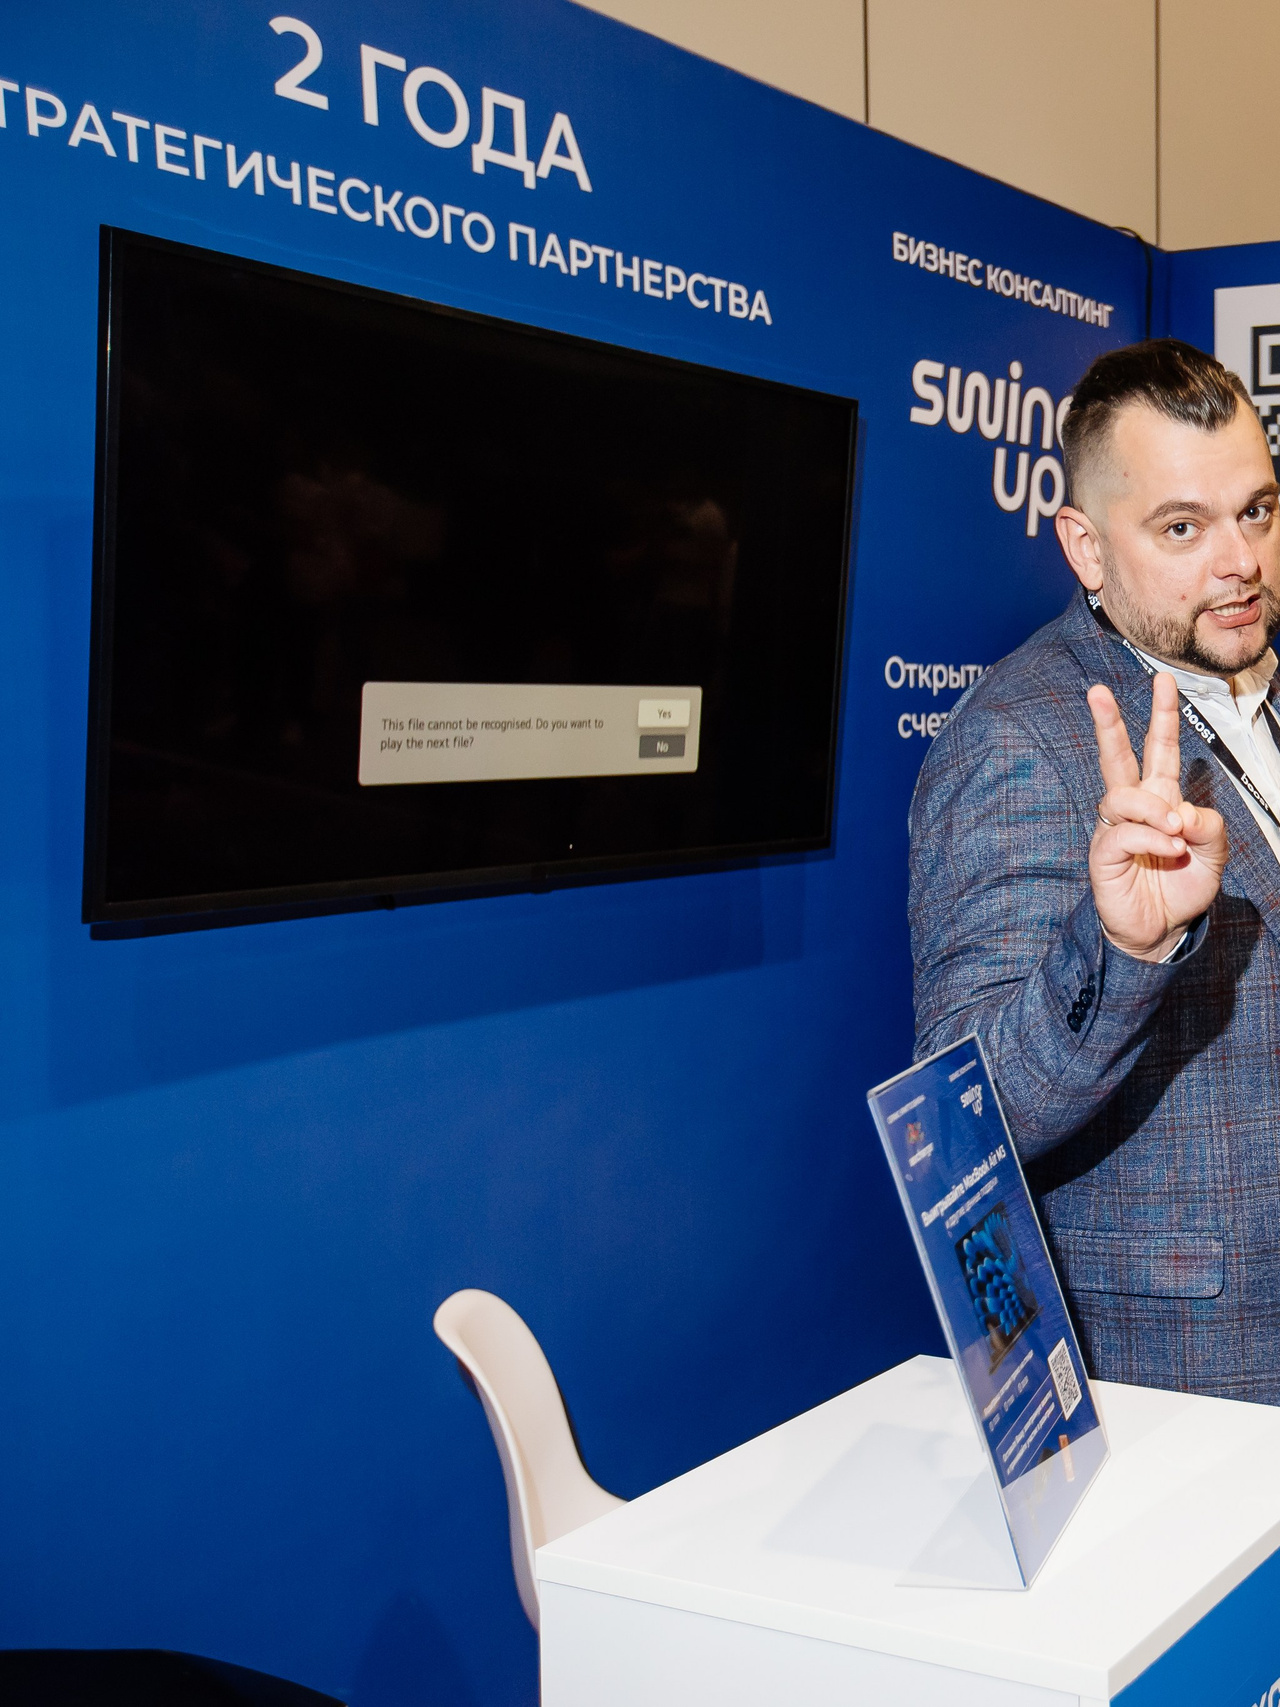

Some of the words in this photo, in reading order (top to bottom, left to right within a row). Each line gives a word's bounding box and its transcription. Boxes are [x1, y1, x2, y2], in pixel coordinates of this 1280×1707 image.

[268, 15, 329, 111] 2
[359, 43, 593, 193] ГОДА
[508, 222, 773, 325] ПАРТНЕРСТВА
[892, 231, 983, 288] БИЗНЕС
[985, 264, 1115, 328] КОНСАЛТИНГ
[910, 359, 1074, 450] swin
[992, 447, 1066, 537] up
[382, 717, 404, 731] This
[408, 717, 425, 731] file
[427, 719, 463, 731] cannot
[466, 717, 478, 730] be
[535, 718, 548, 730] Do
[551, 720, 567, 732] you
[570, 719, 591, 730] want
[594, 719, 604, 730] to
[657, 708, 672, 720] Yes
[1182, 703, 1216, 744] boost
[380, 736, 402, 752] play
[406, 736, 424, 749] the
[427, 737, 450, 749] next
[453, 736, 475, 749] file?
[656, 740, 669, 753] No
[1240, 773, 1270, 811] boost
